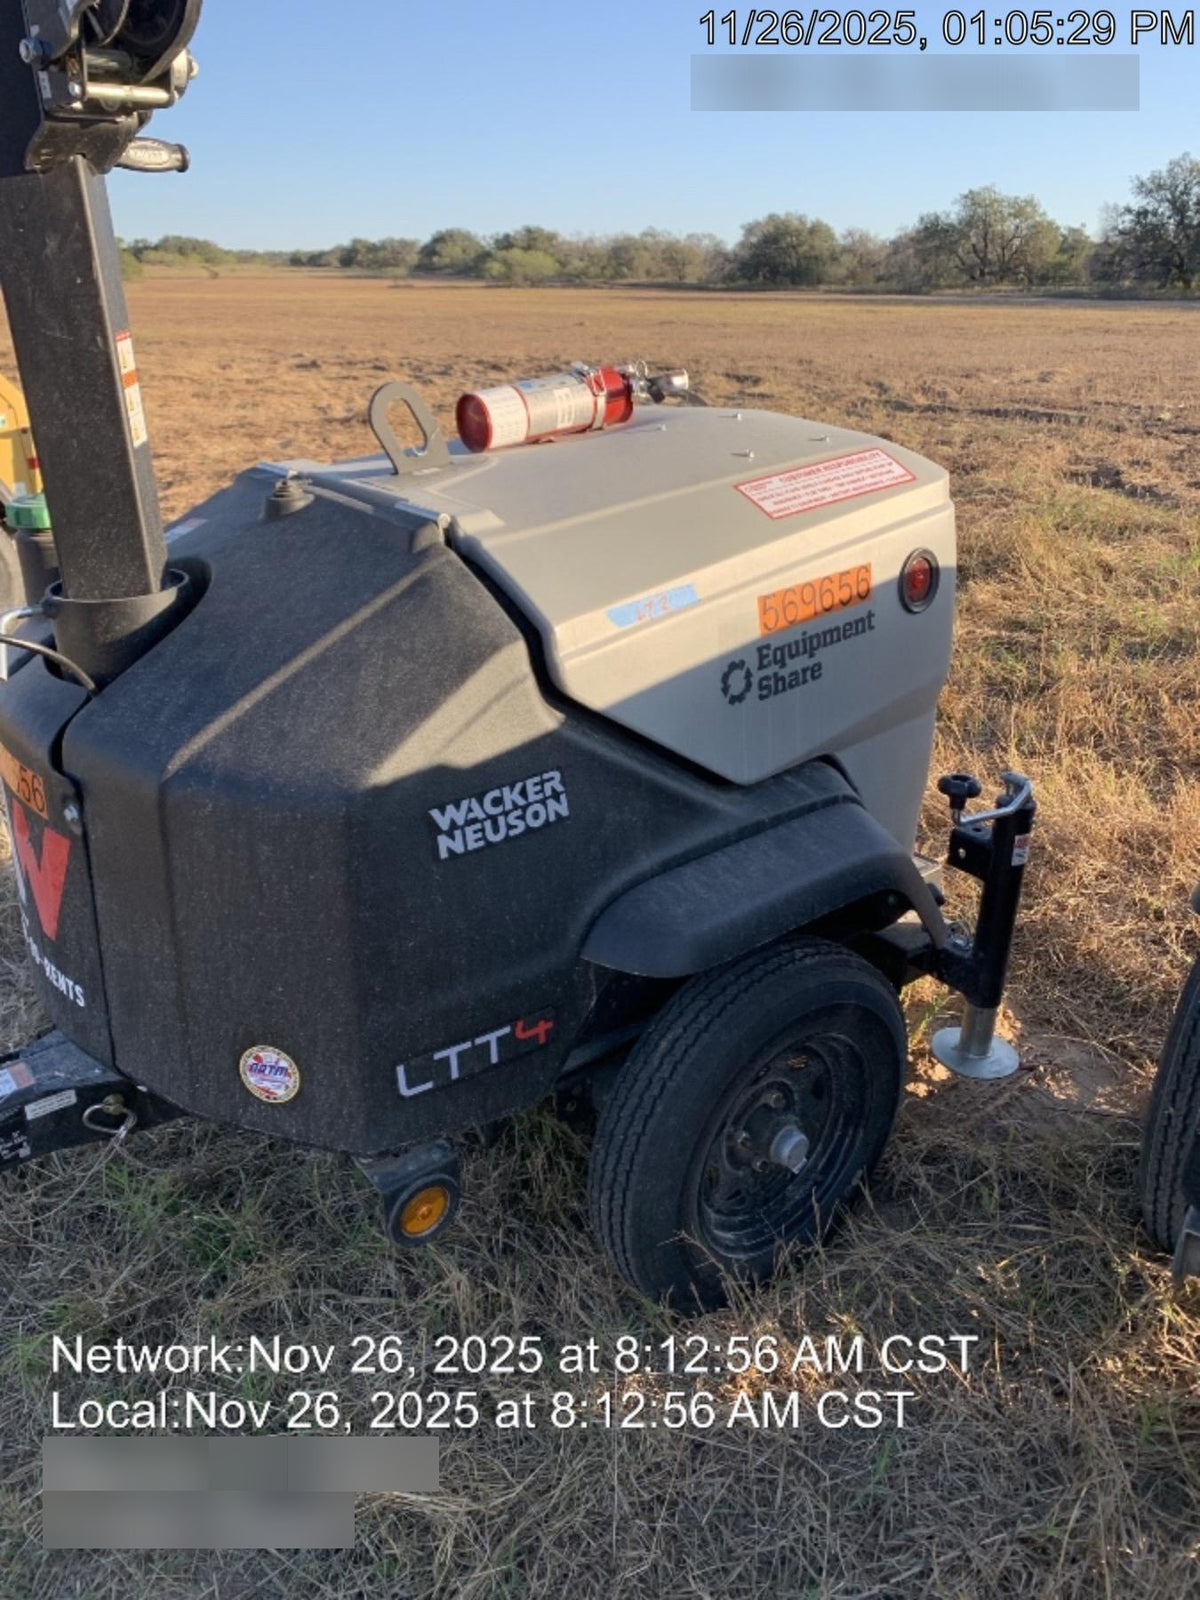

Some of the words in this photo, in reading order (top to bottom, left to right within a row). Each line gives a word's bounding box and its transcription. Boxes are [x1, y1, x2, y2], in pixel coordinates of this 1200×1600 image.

[762, 565, 871, 632] 569656
[756, 609, 876, 671] Equipment
[757, 661, 823, 702] Share
[428, 770, 566, 832] WACKER
[436, 793, 571, 861] NEUSON
[396, 1018, 555, 1098] LTT4
